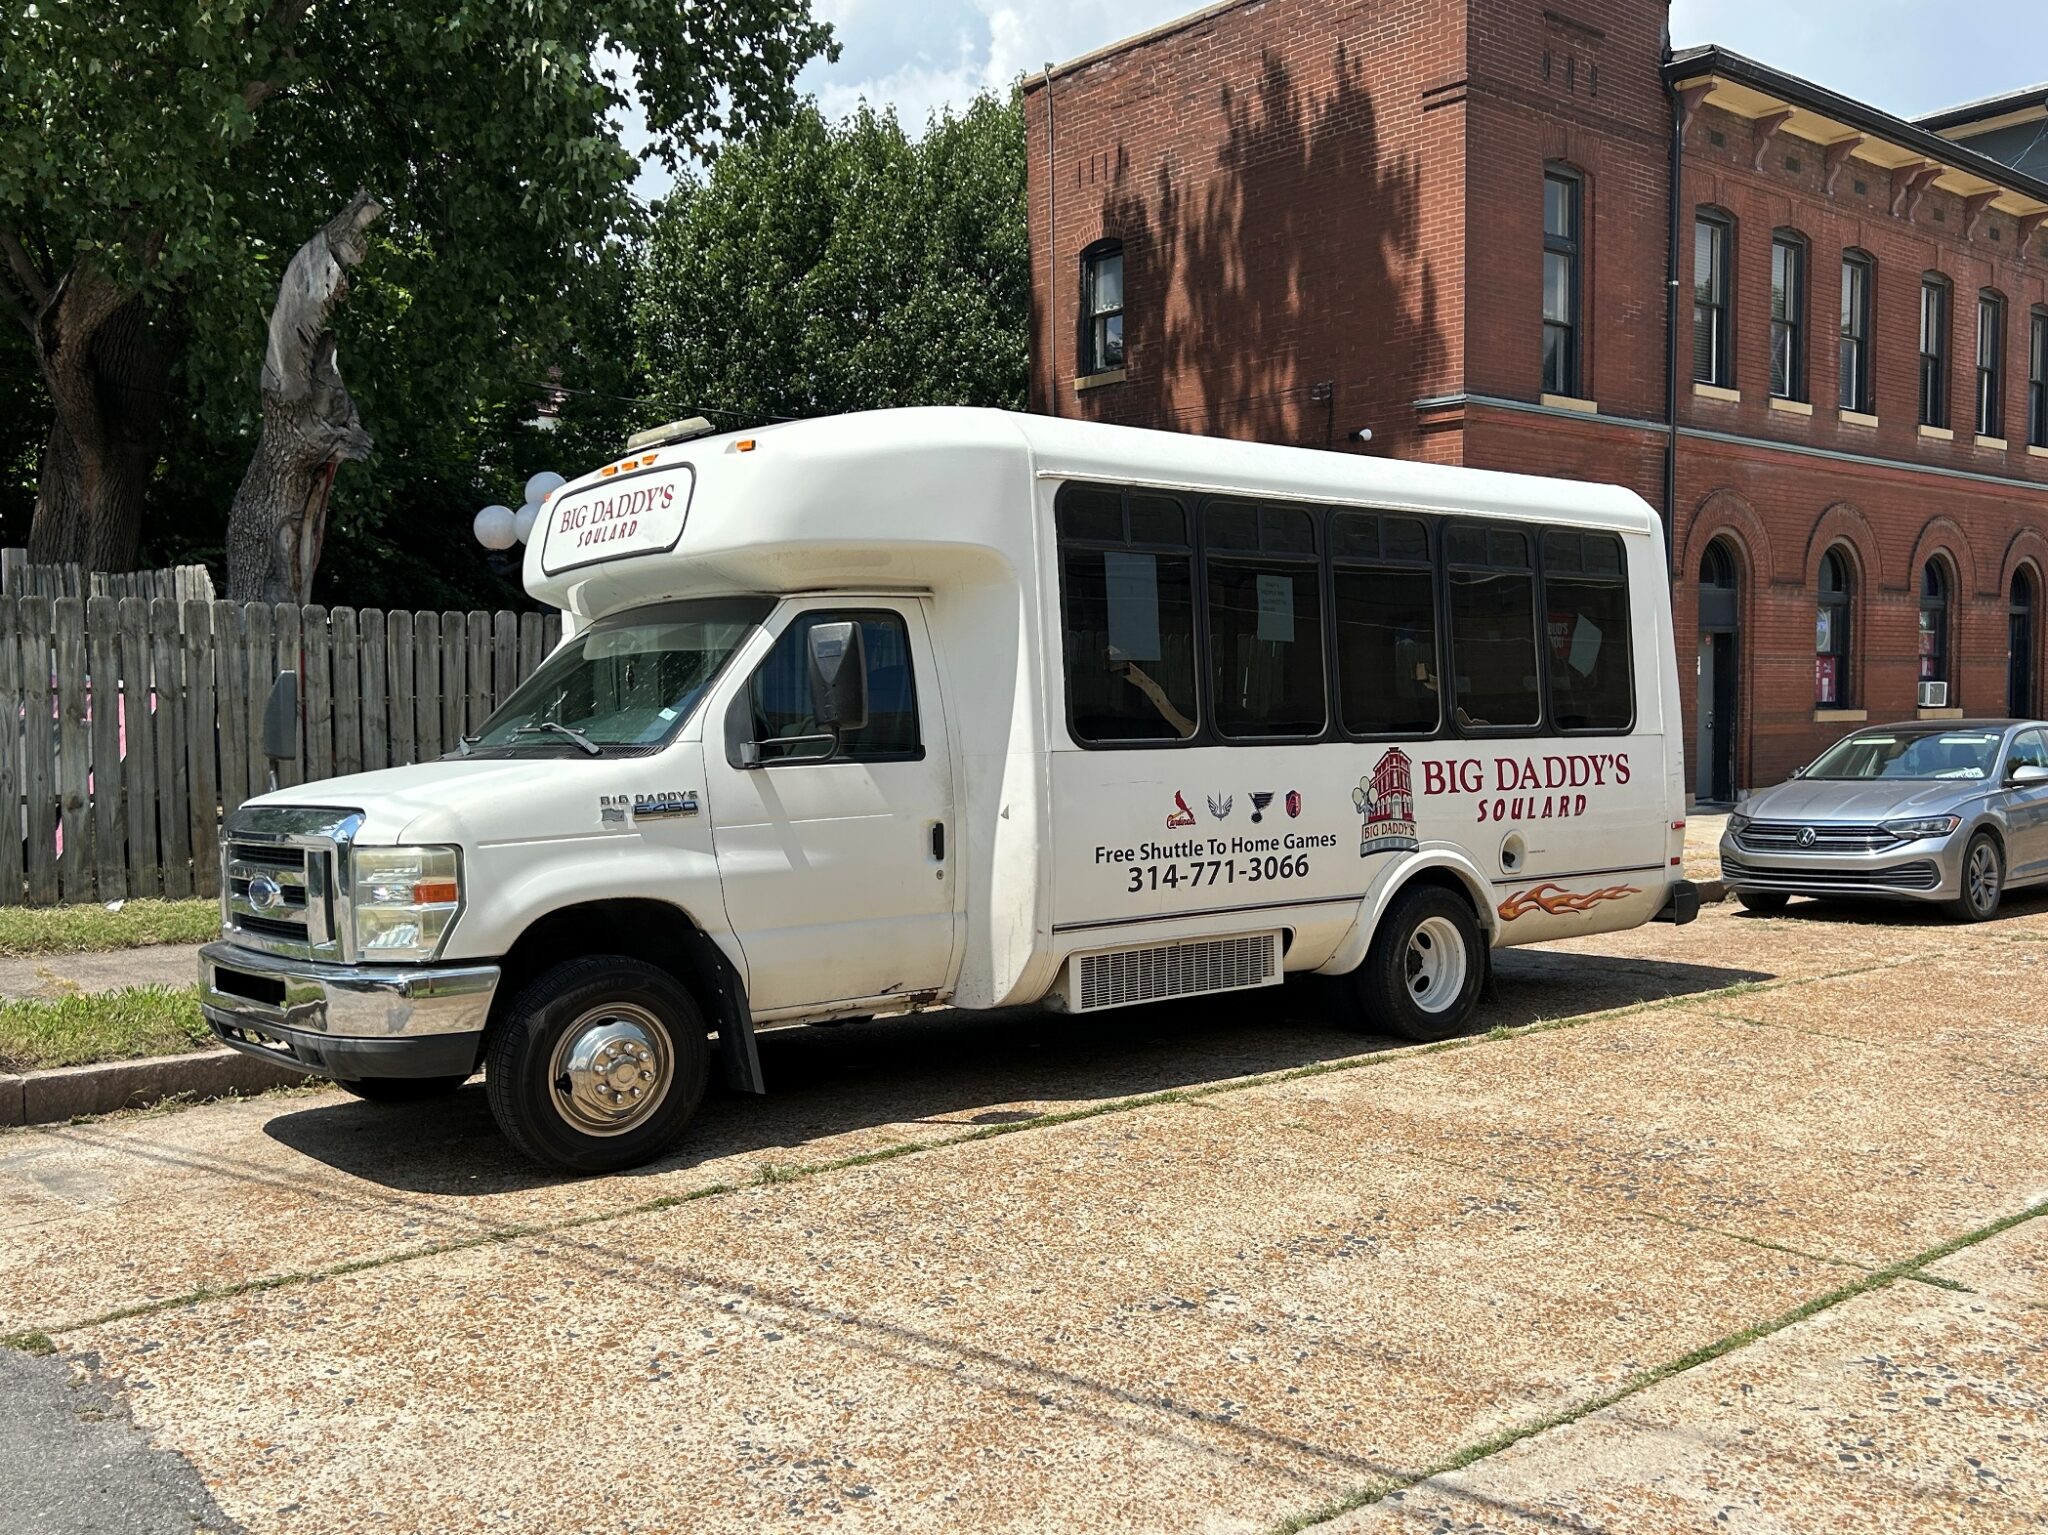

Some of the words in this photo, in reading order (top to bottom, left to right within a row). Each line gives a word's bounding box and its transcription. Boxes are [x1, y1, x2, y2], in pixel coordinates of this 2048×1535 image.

[560, 505, 588, 533] BIG
[591, 484, 675, 524] DADDY'S
[577, 520, 637, 548] SOULARD
[1422, 759, 1484, 795] BIG
[1494, 753, 1631, 791] DADDY'S
[600, 795, 628, 805] BIG
[635, 790, 698, 804] DADDYS
[1477, 794, 1587, 822] SOULARD
[1365, 825, 1379, 839] BIG
[1381, 822, 1415, 836] DADDY'S
[1095, 846, 1134, 863] Free
[1140, 840, 1203, 860] Shuttle
[1207, 838, 1226, 855] To
[1231, 837, 1279, 853] Home
[1283, 833, 1337, 849] Games
[1127, 853, 1309, 892] 314-771-3066
